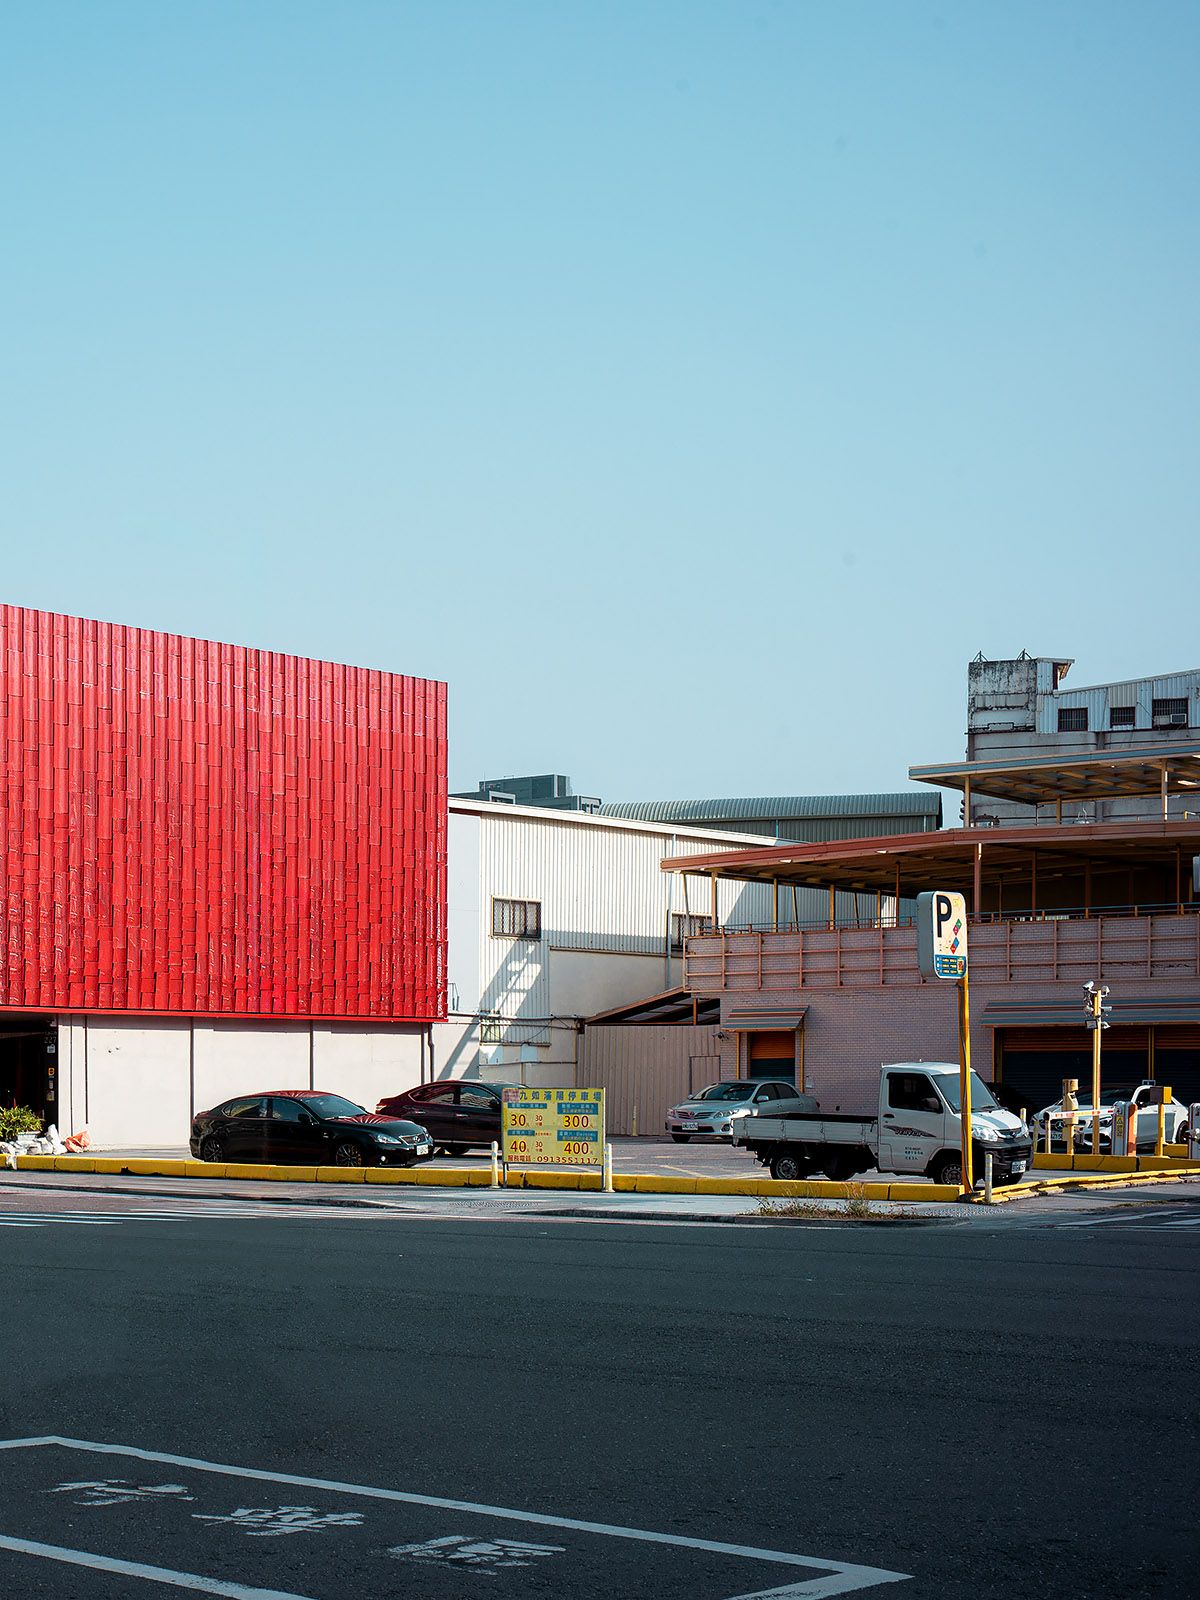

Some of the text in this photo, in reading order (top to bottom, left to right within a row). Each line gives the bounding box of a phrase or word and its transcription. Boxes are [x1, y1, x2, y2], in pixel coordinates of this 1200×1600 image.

[936, 895, 952, 938] P
[520, 1090, 601, 1102] 九如瀋陽停車場
[510, 1114, 526, 1127] 30
[563, 1115, 589, 1128] 300
[510, 1140, 527, 1153] 40
[563, 1142, 589, 1155] 400
